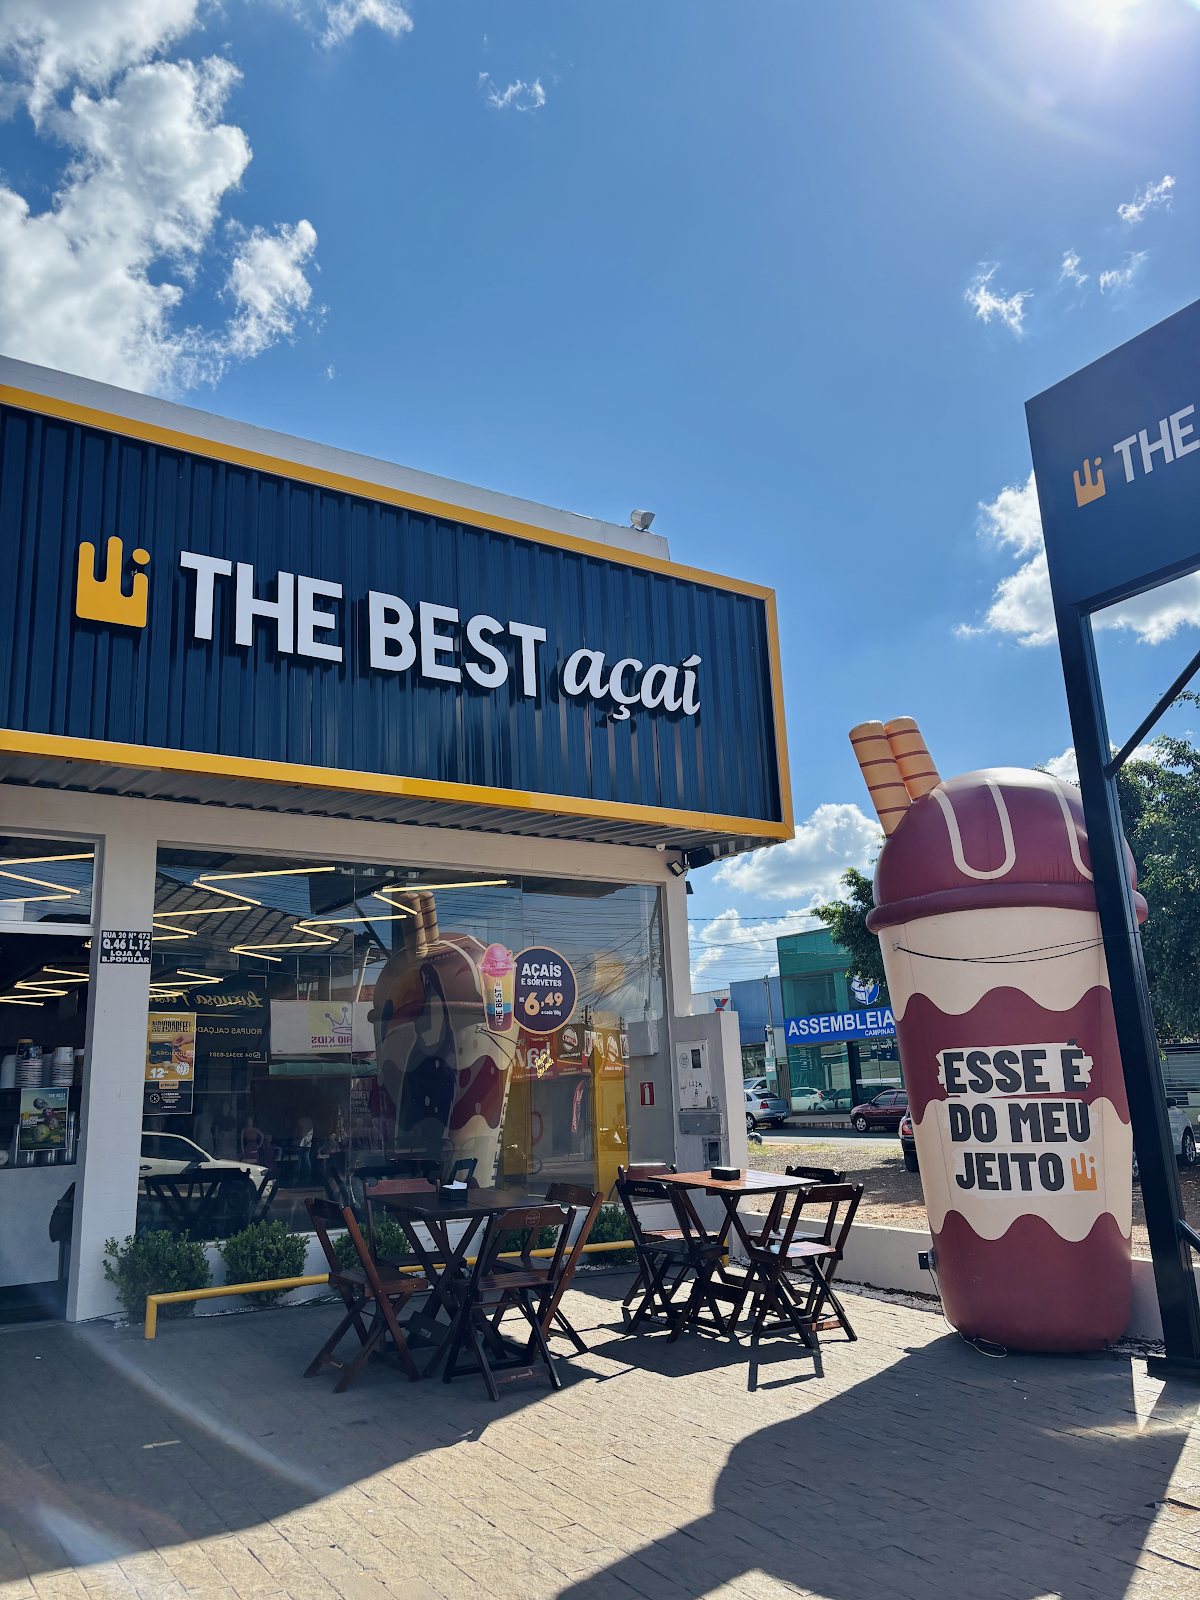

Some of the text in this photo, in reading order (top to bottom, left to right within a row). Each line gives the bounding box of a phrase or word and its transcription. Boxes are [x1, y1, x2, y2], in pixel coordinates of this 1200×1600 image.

[1113, 404, 1200, 483] THE
[180, 550, 701, 720] THE BEST açaí
[102, 931, 117, 939] RUA
[102, 938, 151, 951] Q.46 L.12
[101, 956, 150, 964] B.POPULAR
[521, 961, 562, 979] AÇAÍS
[521, 978, 562, 987] E SORVETES
[494, 988, 503, 1008] BEST
[524, 992, 564, 1016] 6,49
[788, 1009, 896, 1037] ASSEMBLEIA
[864, 1027, 895, 1036] CAMPINAS
[943, 1038, 1087, 1094] ESSE É
[948, 1102, 1091, 1143] DO MEU
[955, 1152, 1065, 1192] JEITO
